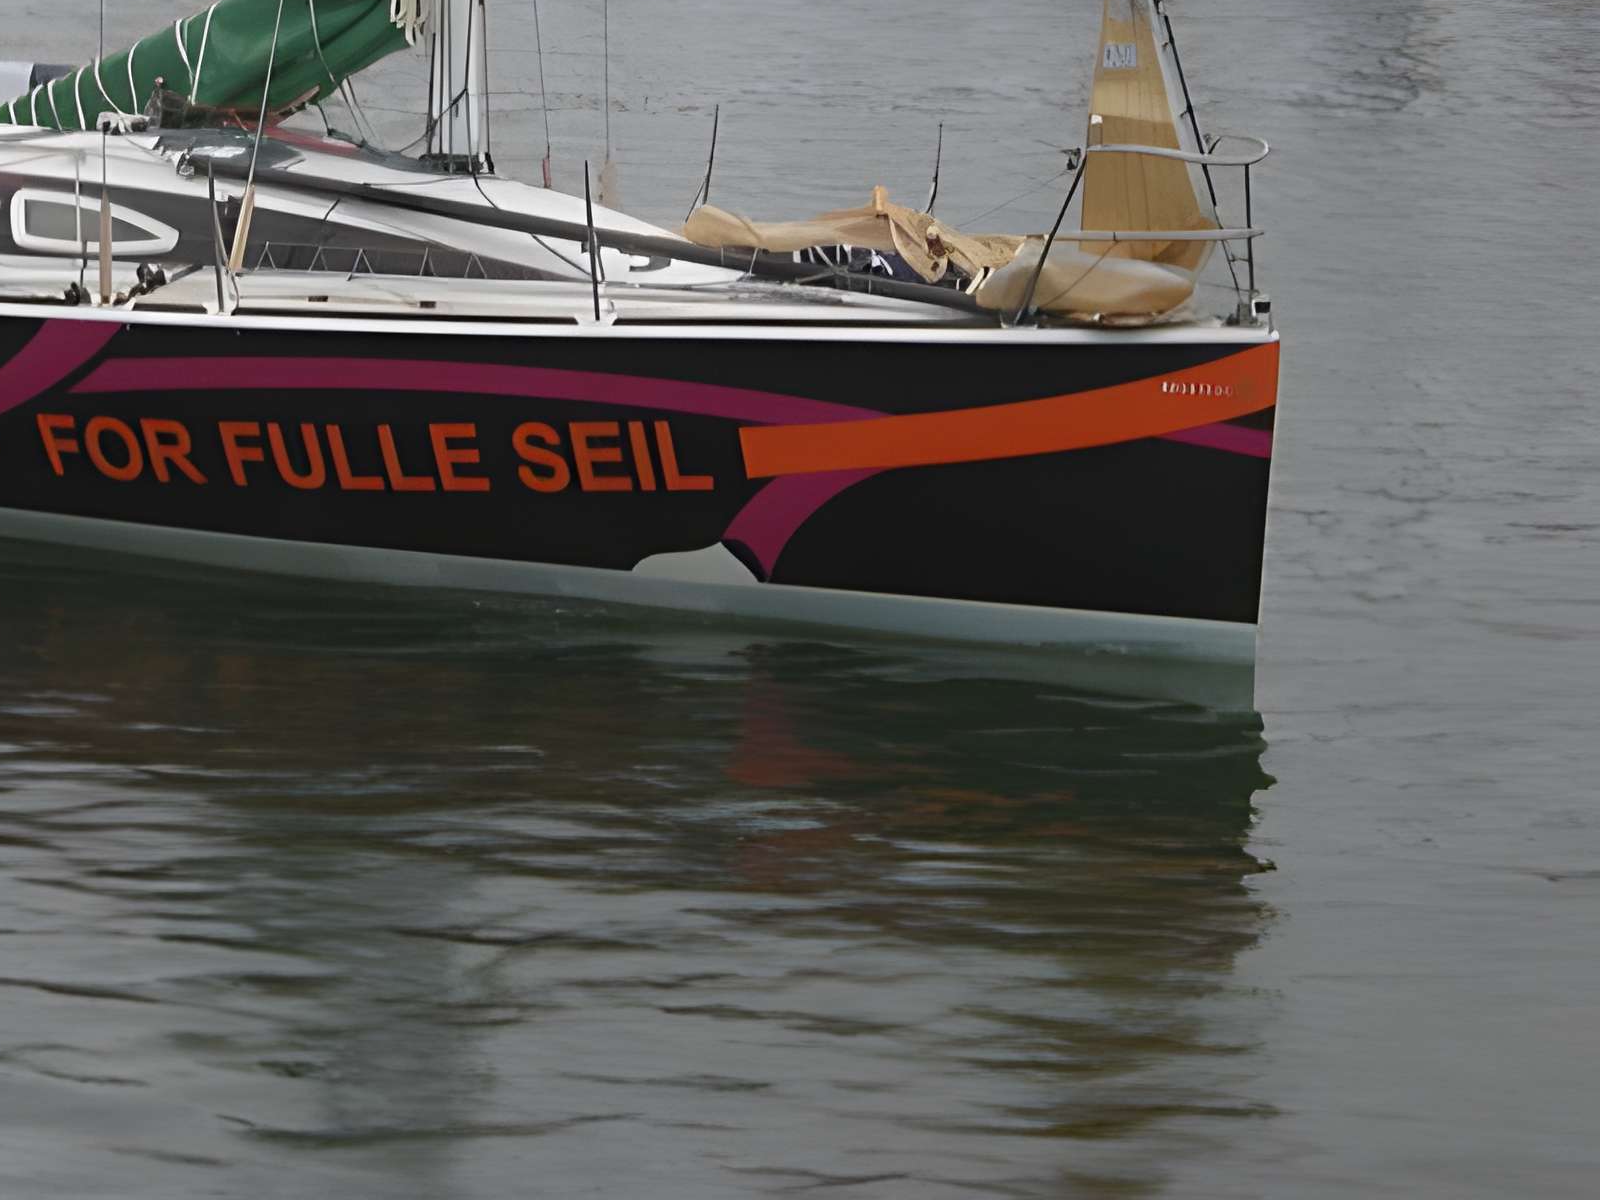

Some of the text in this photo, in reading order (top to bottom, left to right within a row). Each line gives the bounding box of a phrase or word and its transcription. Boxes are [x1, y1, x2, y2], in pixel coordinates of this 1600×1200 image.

[36, 412, 715, 493] FOR FULLE SEIL
